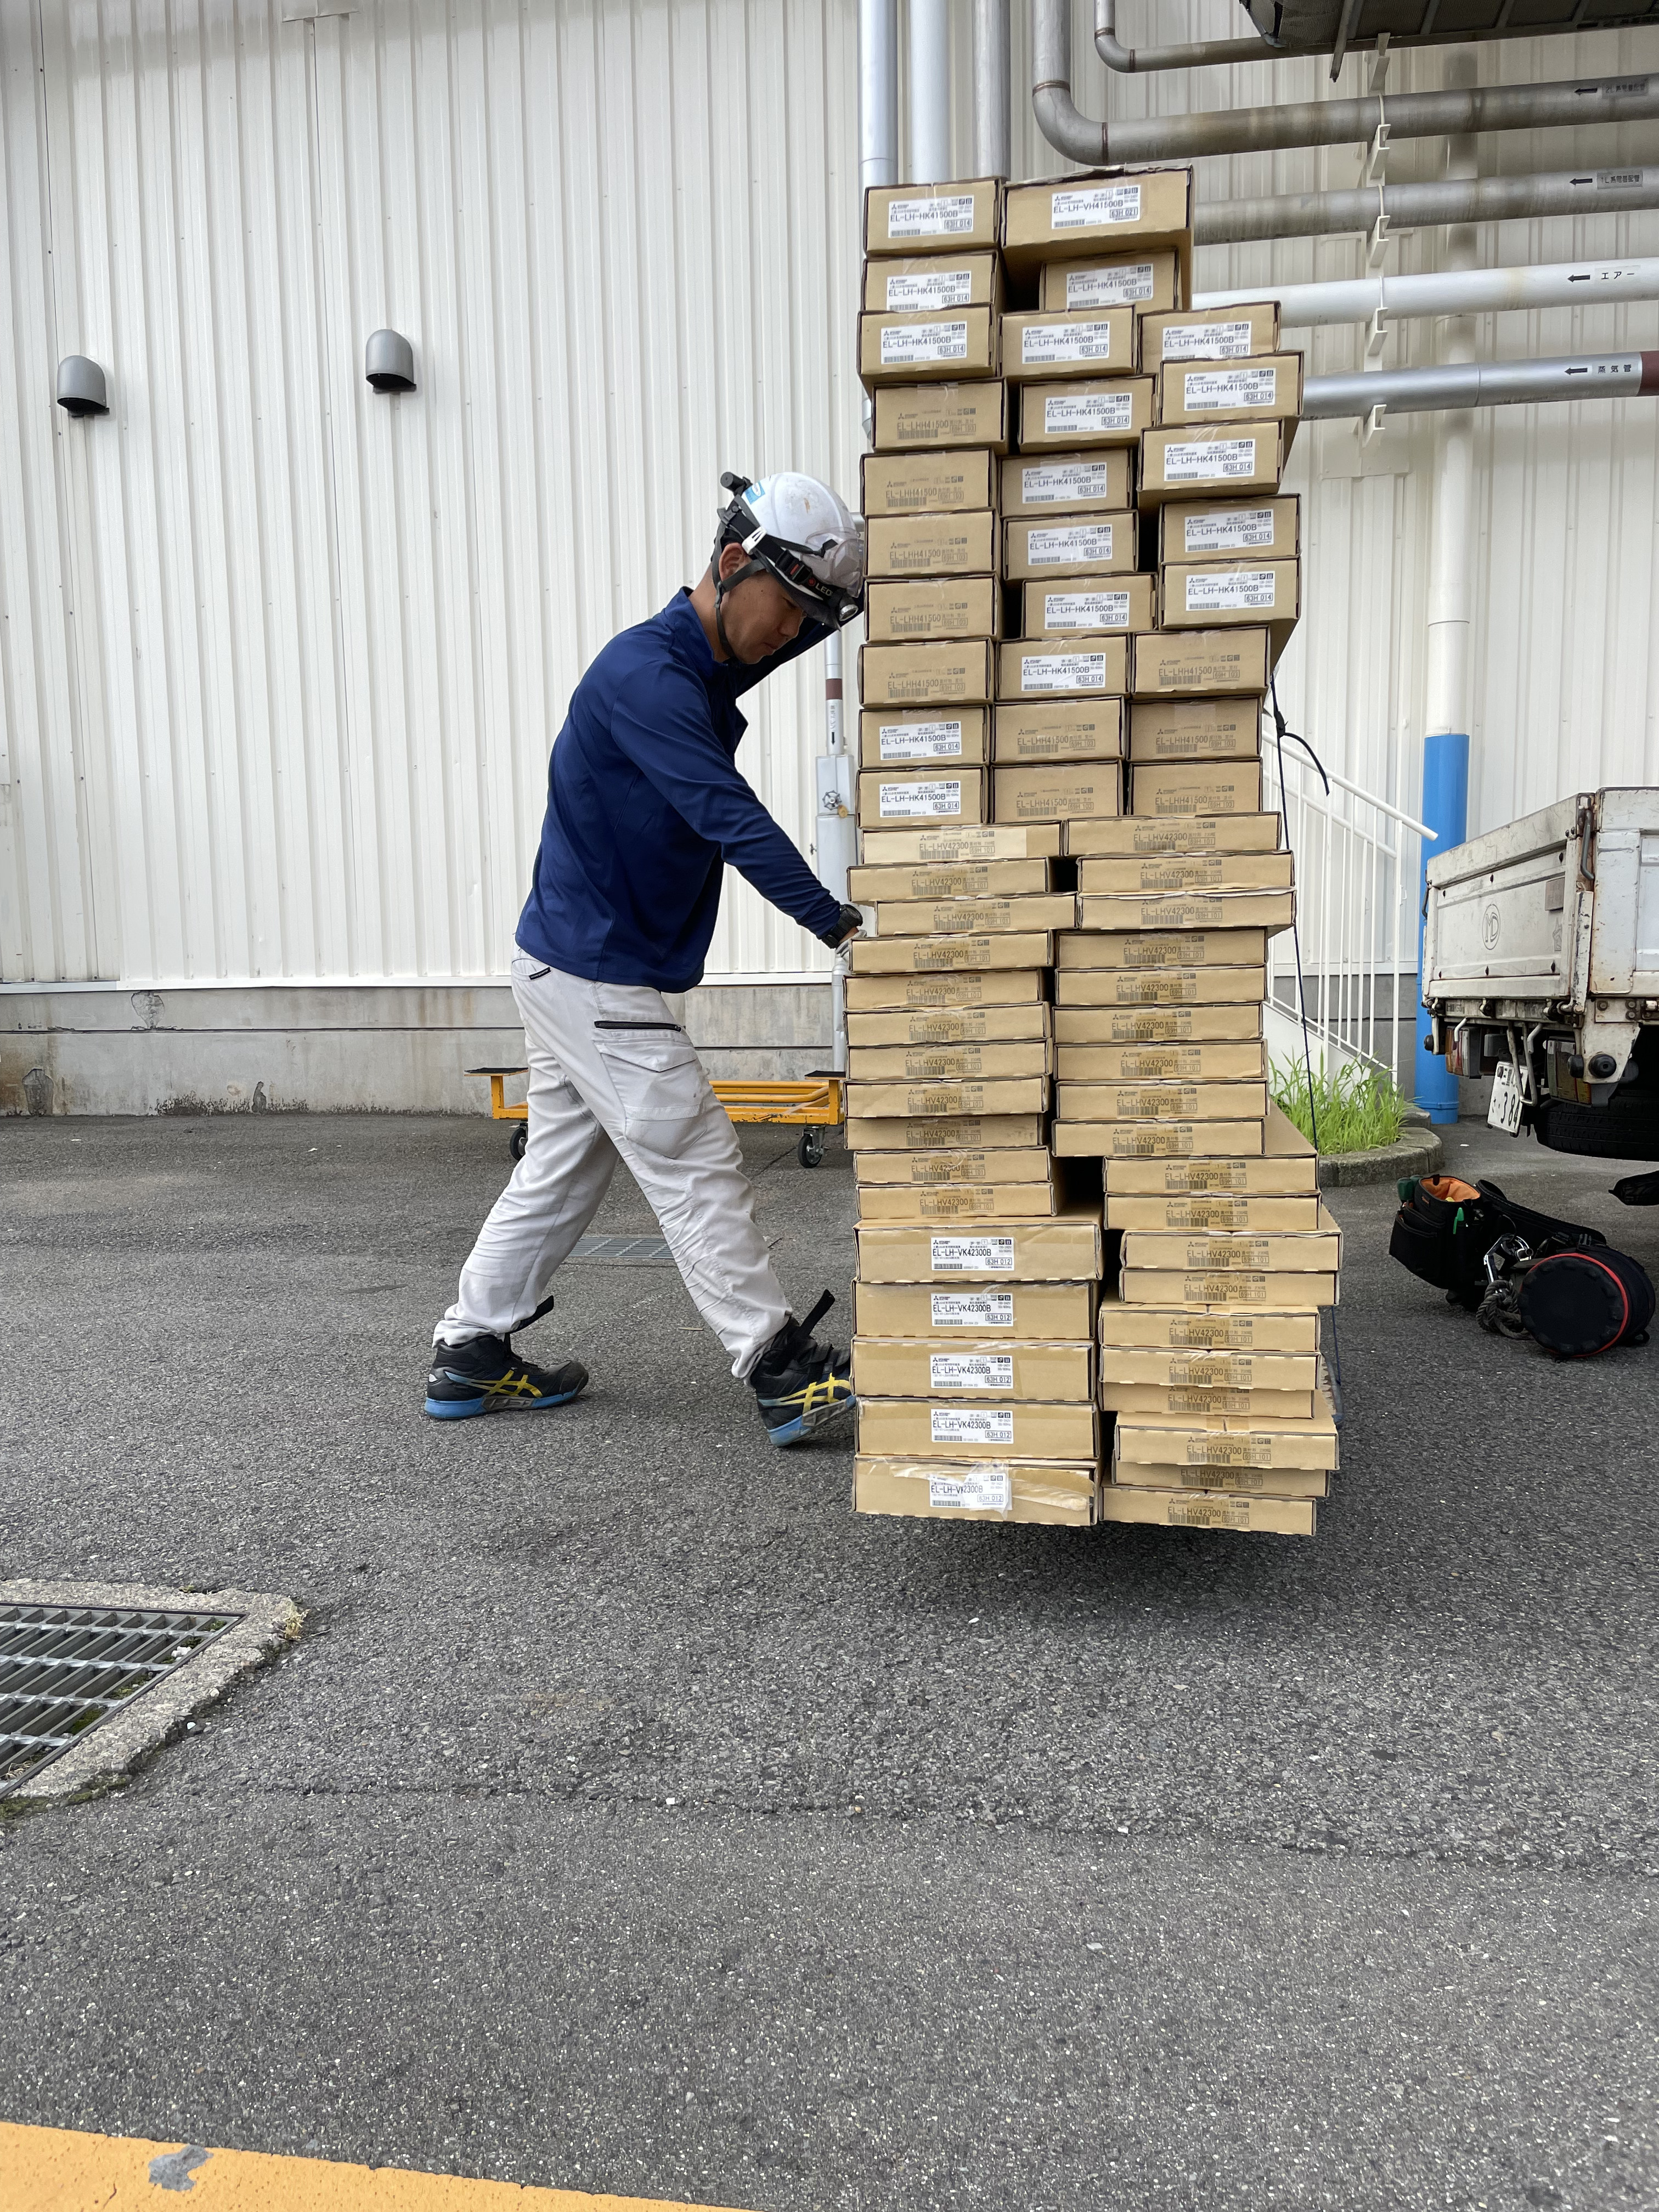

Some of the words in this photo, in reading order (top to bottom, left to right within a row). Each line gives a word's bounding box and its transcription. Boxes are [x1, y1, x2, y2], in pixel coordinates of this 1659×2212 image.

[1053, 200, 1123, 213] EL-LH-VH41500B
[890, 210, 958, 222] EL-LH-HK41500B
[1068, 278, 1137, 293] EL-LH-HK41500B
[889, 285, 956, 296] EL-LH-HK41500B
[883, 336, 951, 348] EL-LH-HK41500B
[1024, 336, 1093, 347] EL-LH-HK41500B
[1164, 336, 1234, 348] EL-LH-HK41500B
[1187, 382, 1259, 394] EL-LH-HK41500B
[1047, 408, 1115, 417] EL-LH-HK41500B
[1166, 454, 1238, 465] EL-LH-HK41500B
[1024, 477, 1091, 488] EL-LH-HK41500B
[1187, 524, 1256, 537] EL-LH-HK41500B
[1030, 539, 1097, 550] EL-LH-HK41500B
[815, 583, 833, 596] LED
[1188, 585, 1259, 595] EL-LH-HK41500B
[1047, 605, 1113, 614] EL-LH-HK41500B
[1023, 667, 1090, 676] EL-LH-HK41500B
[881, 735, 946, 745] EL-LH-HK41500B
[882, 794, 946, 803] EL-LH-HK41500B
[1133, 833, 1187, 842] EL-LHV42300
[919, 842, 969, 851] EL-LHV42300
[1141, 871, 1193, 879] EL-LHV42300
[912, 878, 962, 887] EL-LHV42300
[1141, 907, 1194, 916] EL-LHV42300
[933, 913, 984, 922] EL-LHV42300
[913, 950, 964, 960] EL-LHV42300
[1124, 946, 1176, 955] EL-LHV42300
[906, 988, 955, 996] EL-LHV42300
[1116, 984, 1169, 992] EL-LHV42300
[909, 1023, 960, 1031] EL-LHV42300
[1112, 1022, 1164, 1030] EL-LHV42300
[905, 1058, 955, 1066] EL-LHV42300
[1120, 1059, 1173, 1068] EL-LHV42300
[908, 1096, 957, 1104] EL-LHV42300
[1117, 1098, 1169, 1107] EL-LHV42300
[906, 1130, 955, 1138] EL-LHV42300
[1165, 1173, 1218, 1181] EL-LHV42300
[919, 1198, 968, 1206] EL-LHV42300
[1184, 1284, 1238, 1293] EL-LHV42300
[1169, 1328, 1223, 1337] EL-LHV42300
[1169, 1367, 1223, 1375] EL-LHV42300
[1168, 1395, 1221, 1403] EL-LHV42300
[933, 1420, 991, 1429] EL-LH-VK42300B
[1187, 1446, 1242, 1454] EL-LHV42300
[1181, 1470, 1234, 1479] EL-LHV42300
[1168, 1507, 1221, 1517] EL-LHV42300
